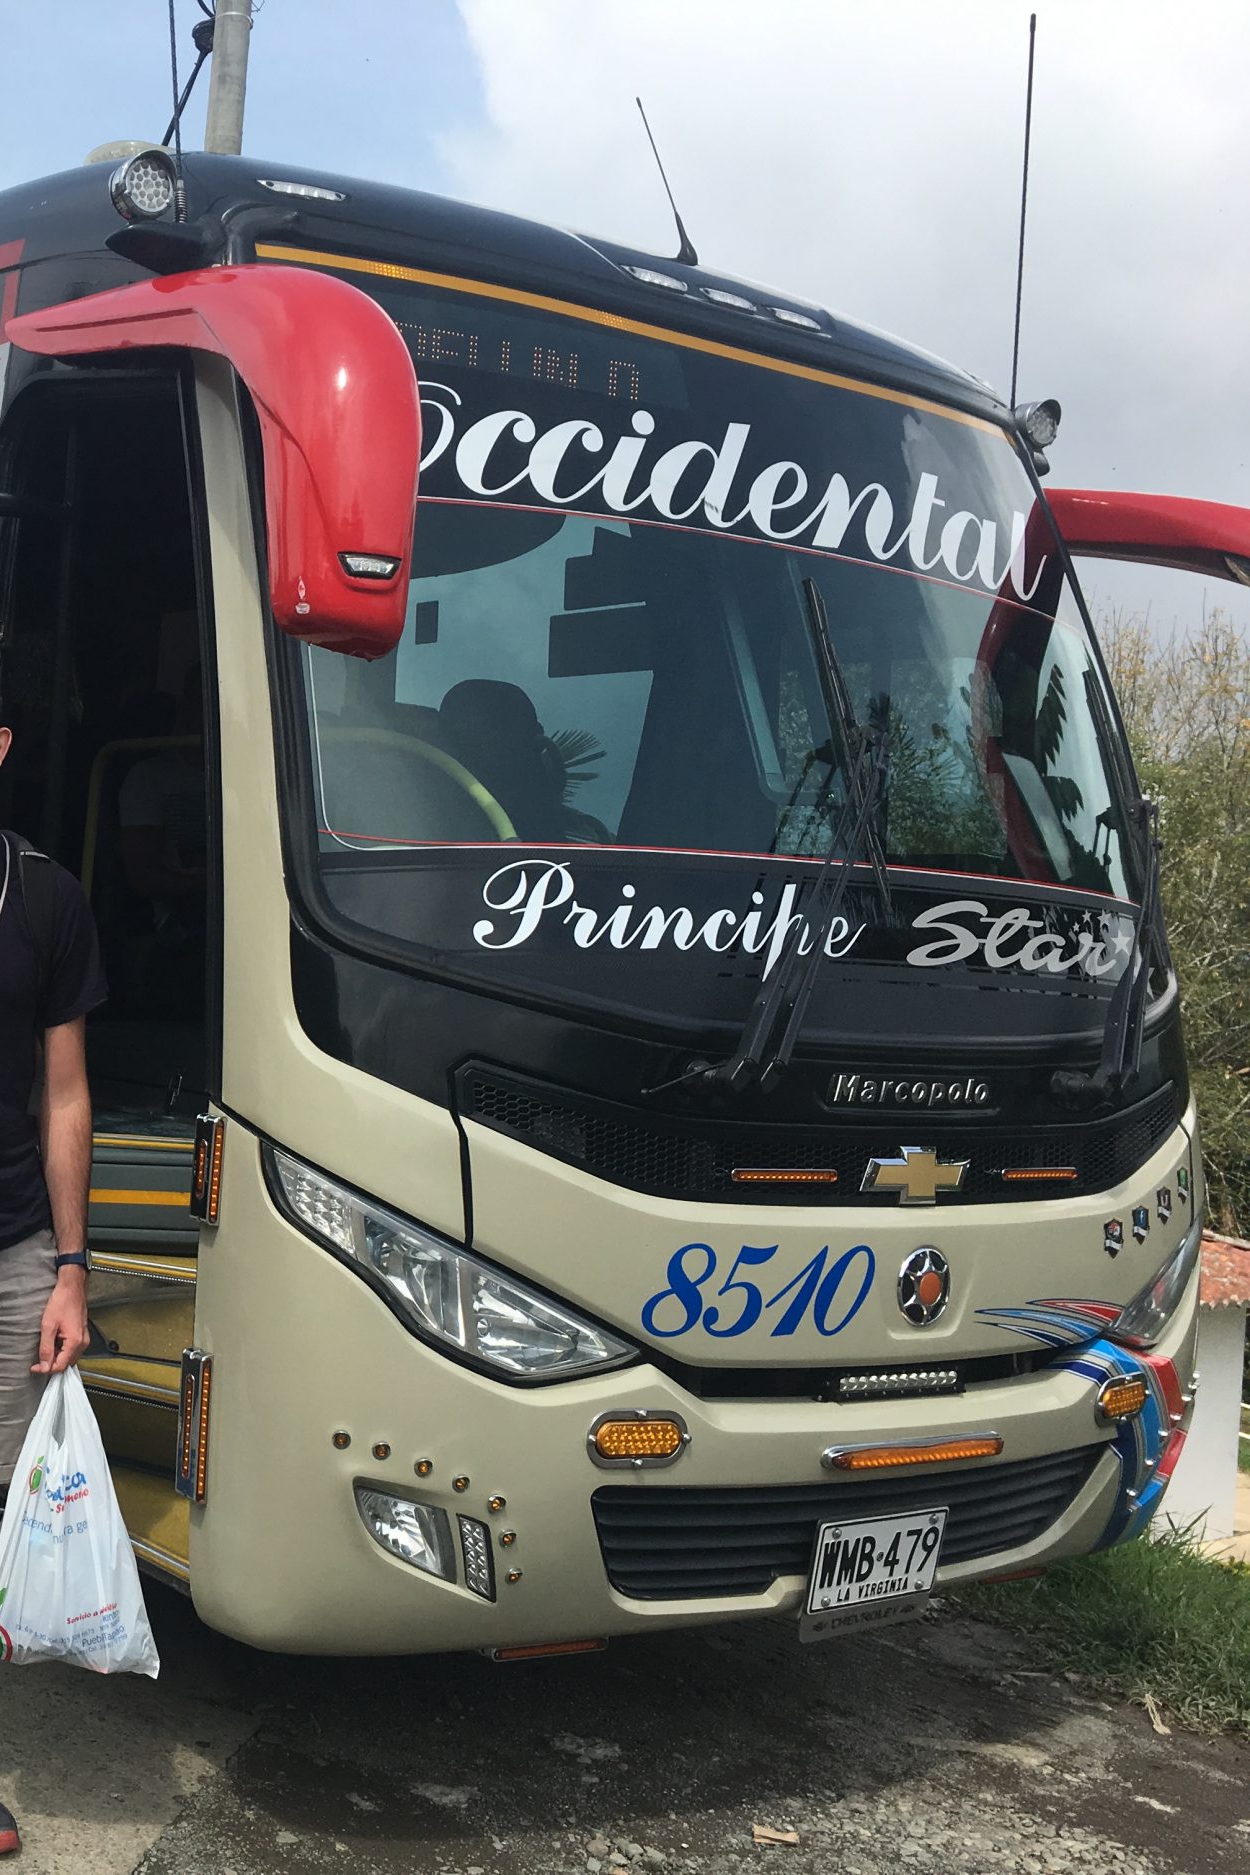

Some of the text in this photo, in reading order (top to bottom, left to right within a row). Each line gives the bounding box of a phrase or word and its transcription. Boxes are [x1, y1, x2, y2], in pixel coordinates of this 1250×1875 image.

[472, 859, 867, 982] Principe
[906, 900, 1120, 974] Star
[832, 1073, 991, 1107] Marcopolo
[641, 1243, 876, 1338] 8510
[819, 1526, 940, 1589] WMB 479
[836, 1577, 908, 1602] LA VIRGINIA
